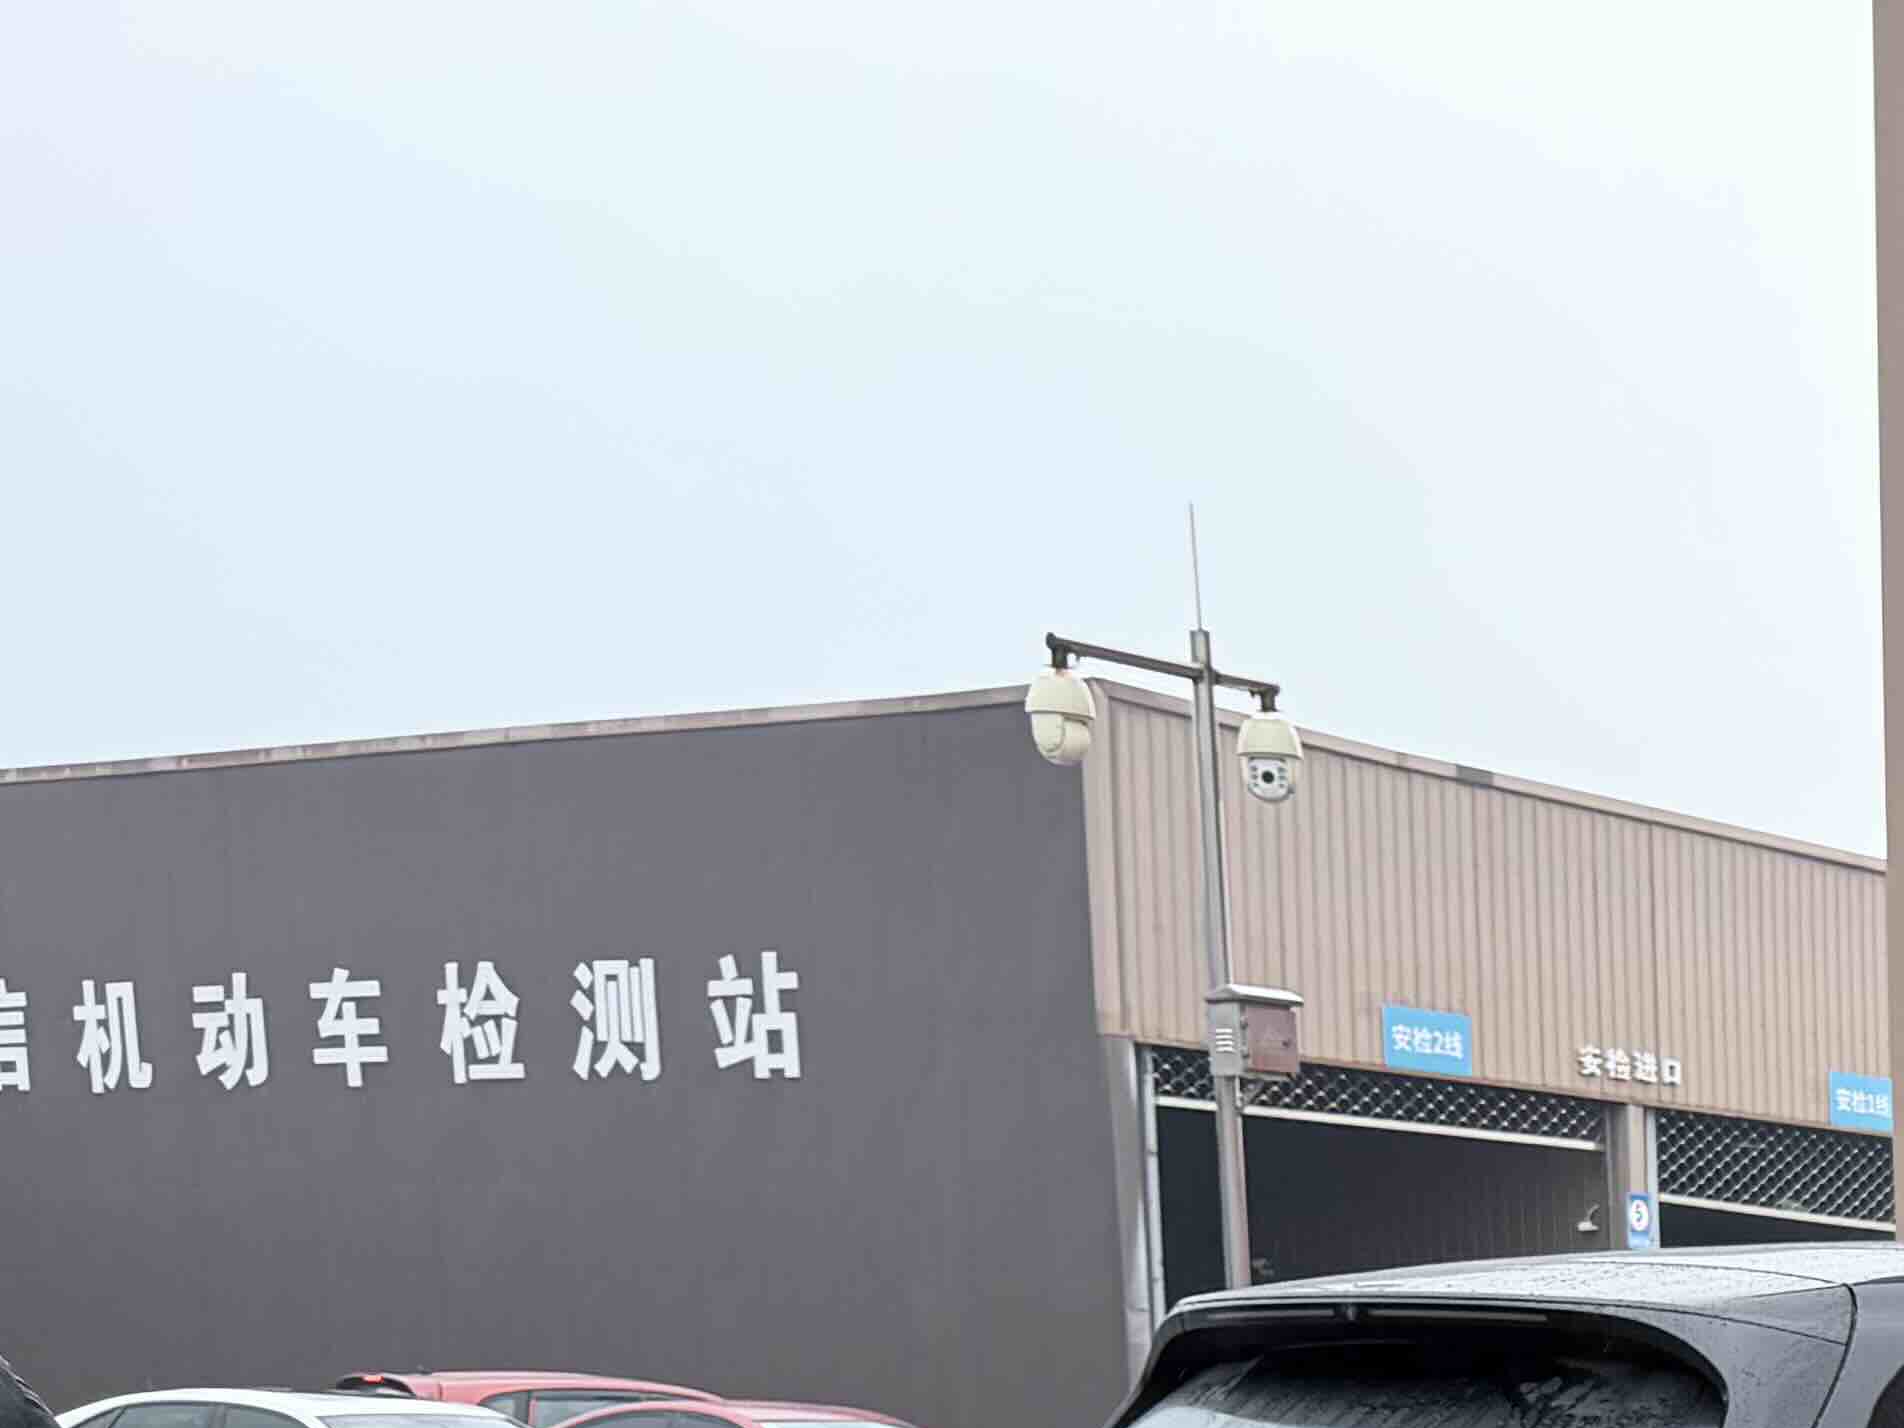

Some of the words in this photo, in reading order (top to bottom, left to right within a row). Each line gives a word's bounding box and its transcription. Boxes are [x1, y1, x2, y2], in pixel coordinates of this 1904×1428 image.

[1391, 1023, 1464, 1061] 安检2线
[1576, 1044, 1682, 1087] 安检进口
[1834, 1086, 1889, 1116] 安检1线
